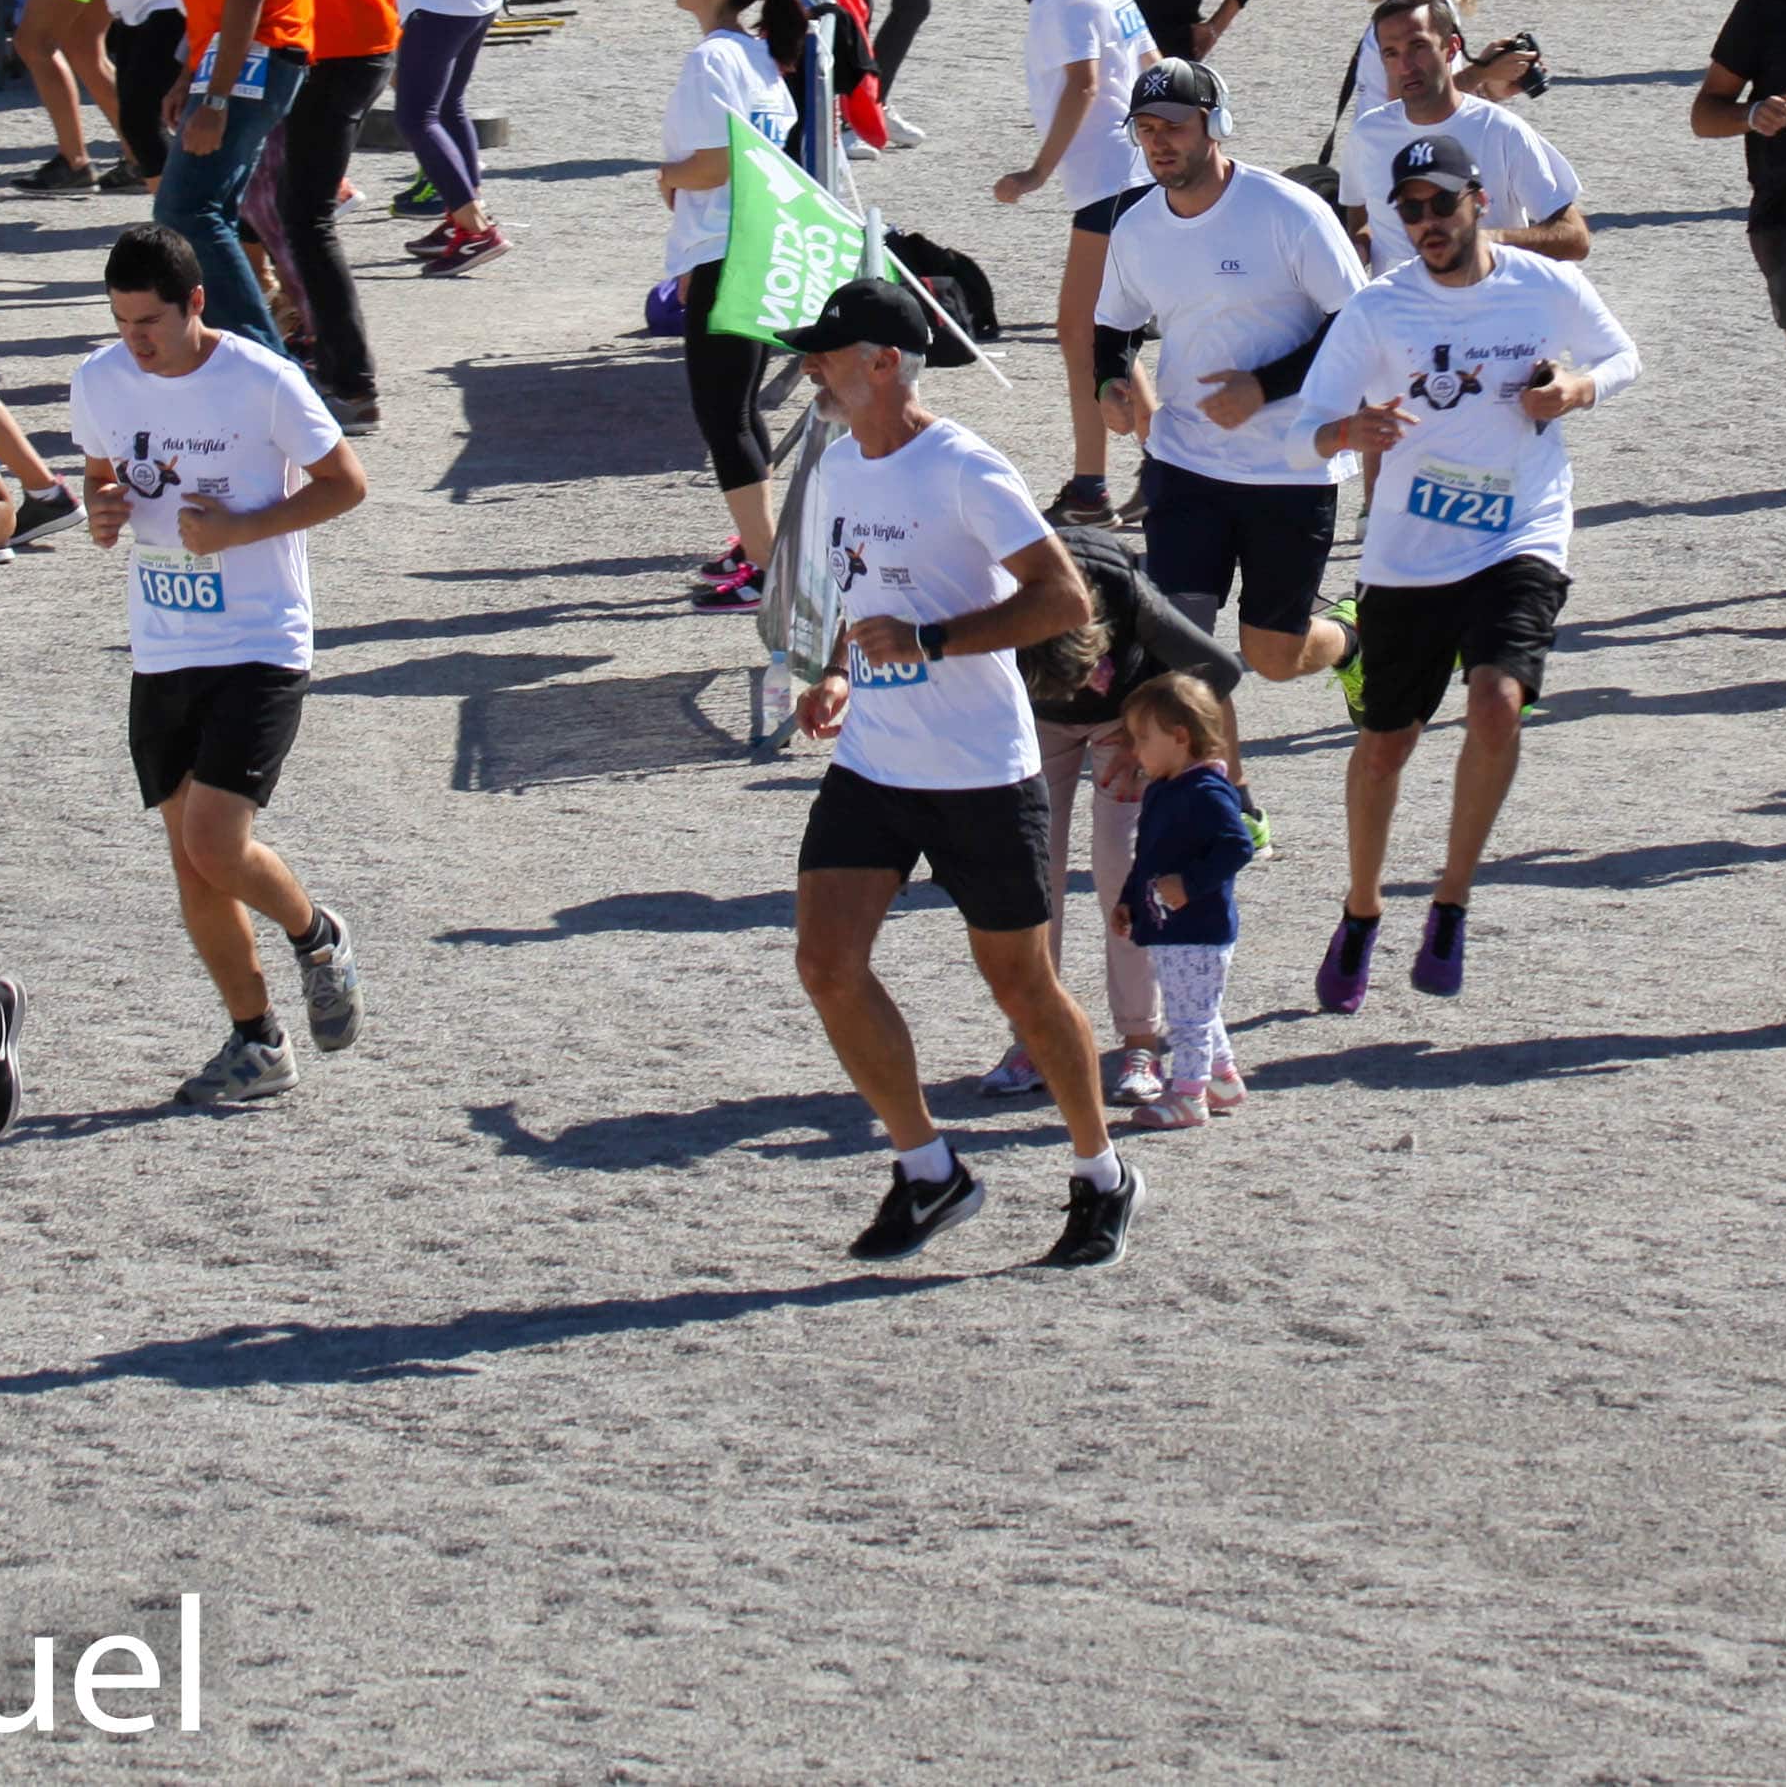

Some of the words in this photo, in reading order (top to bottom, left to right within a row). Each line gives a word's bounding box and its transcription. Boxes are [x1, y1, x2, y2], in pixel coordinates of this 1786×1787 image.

[1220, 259, 1241, 272] CIS
[162, 437, 185, 452] Avis
[185, 438, 228, 456] Vérifiés
[1415, 481, 1508, 529] 1724
[142, 572, 218, 609] 1806
